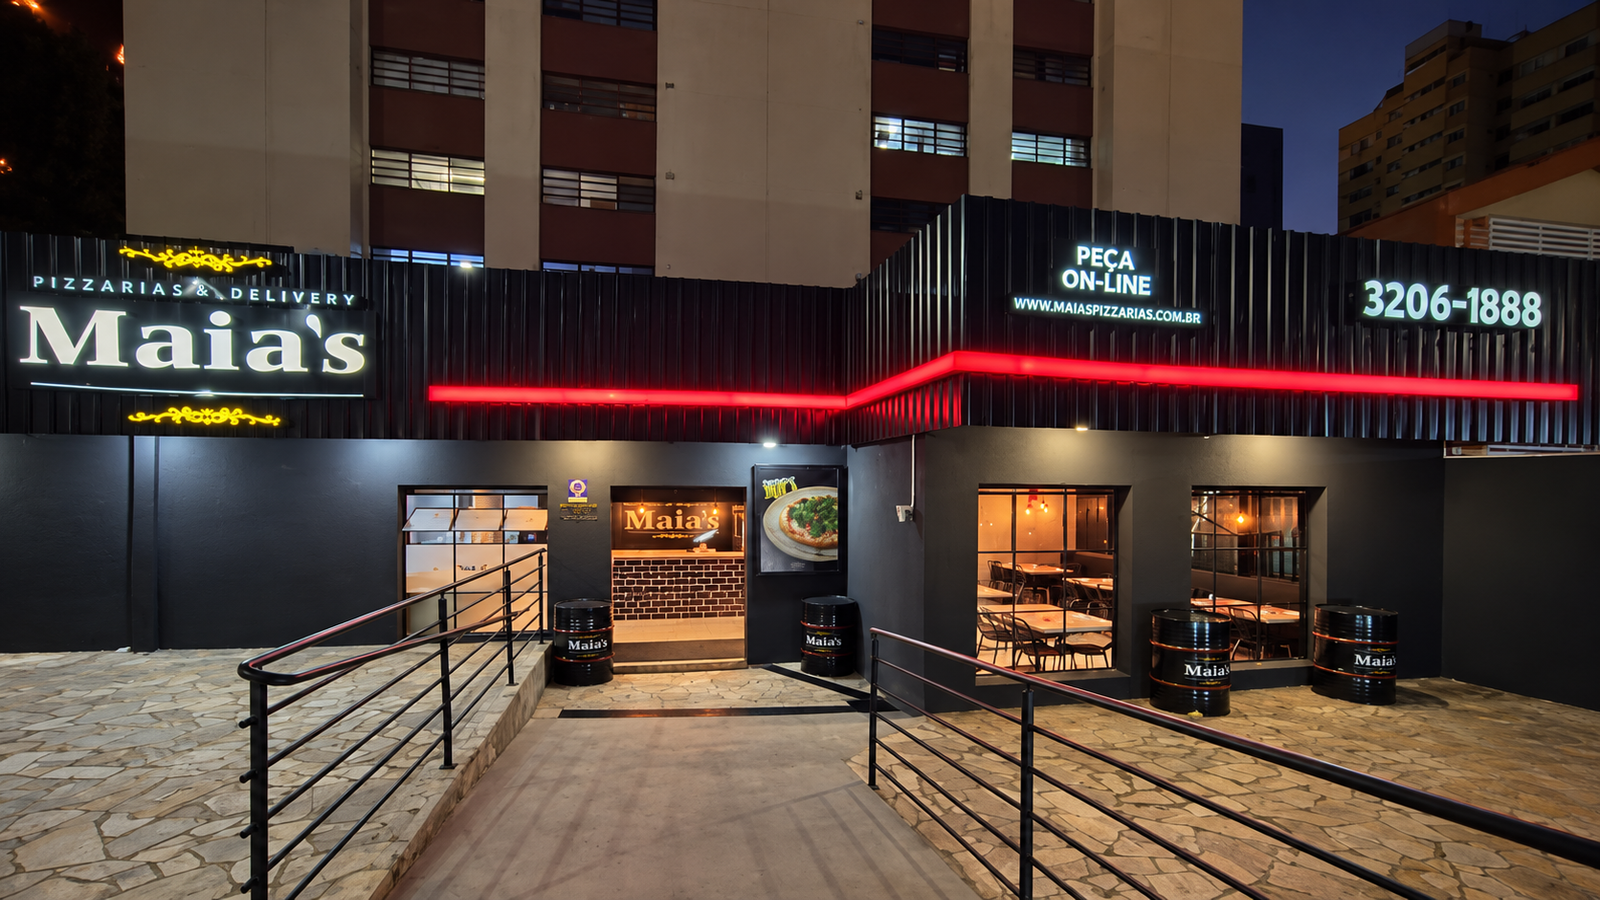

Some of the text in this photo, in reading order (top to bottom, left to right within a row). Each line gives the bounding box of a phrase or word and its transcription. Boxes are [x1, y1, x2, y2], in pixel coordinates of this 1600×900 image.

[1076, 245, 1136, 273] PEÇA
[33, 275, 355, 306] PIZZARIAS & DELIVERY
[1061, 268, 1152, 296] ON-LINE
[1013, 297, 1202, 324] WWW.MAIASPIZZARIAS.COM.BR
[1362, 279, 1542, 328] 3206-1888
[19, 305, 366, 374] Maia's
[624, 509, 720, 530] Maia's
[568, 638, 608, 650] Maia's
[806, 634, 842, 646] Maia's
[1183, 663, 1230, 677] Maia's
